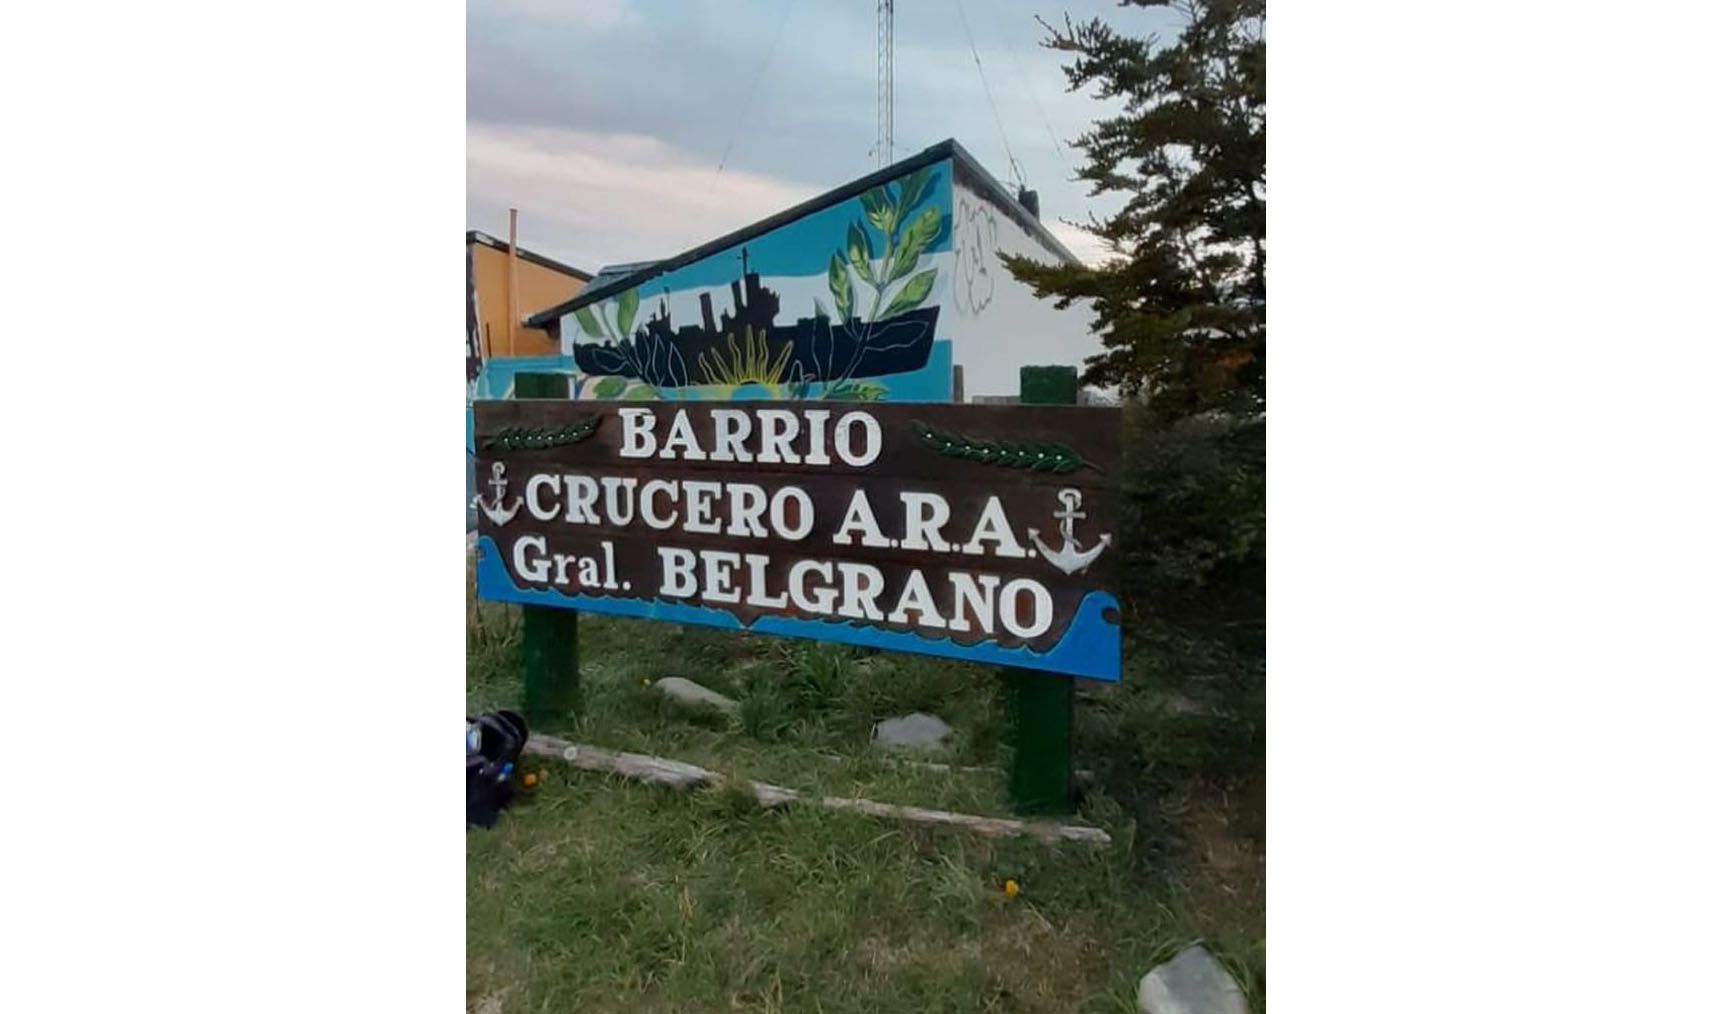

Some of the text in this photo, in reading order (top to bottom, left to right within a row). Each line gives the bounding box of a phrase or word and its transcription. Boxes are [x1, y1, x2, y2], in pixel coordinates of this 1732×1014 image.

[618, 407, 882, 467] BARRIO
[525, 473, 1037, 559] CRUCERO A.R.A.
[512, 535, 1054, 639] Gral. BELGRANO
